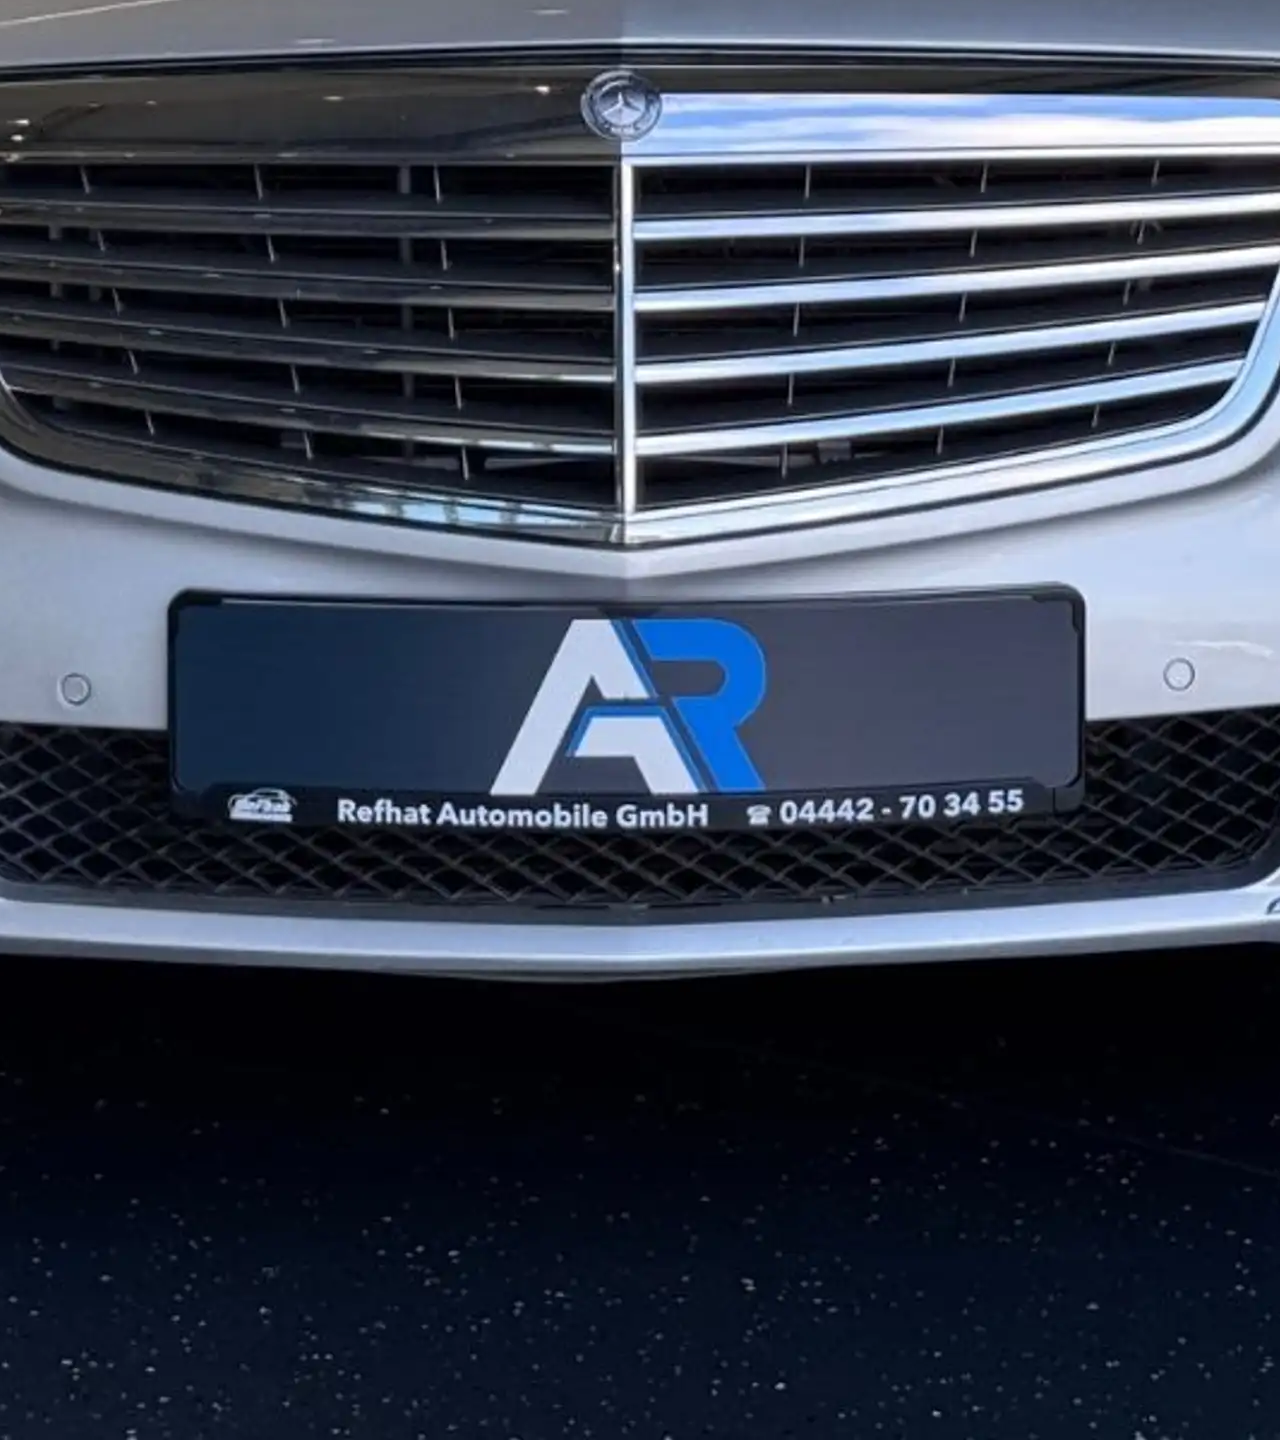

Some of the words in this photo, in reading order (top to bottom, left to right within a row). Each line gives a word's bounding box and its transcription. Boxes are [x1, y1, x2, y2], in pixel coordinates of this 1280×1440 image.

[488, 618, 767, 796] AR
[336, 798, 430, 826] Refhat
[435, 801, 609, 829] Automobile
[615, 802, 709, 829] GmbH
[779, 797, 875, 825] 04442
[898, 794, 937, 820] 70
[943, 791, 982, 818] 34
[987, 788, 1025, 814] 55
